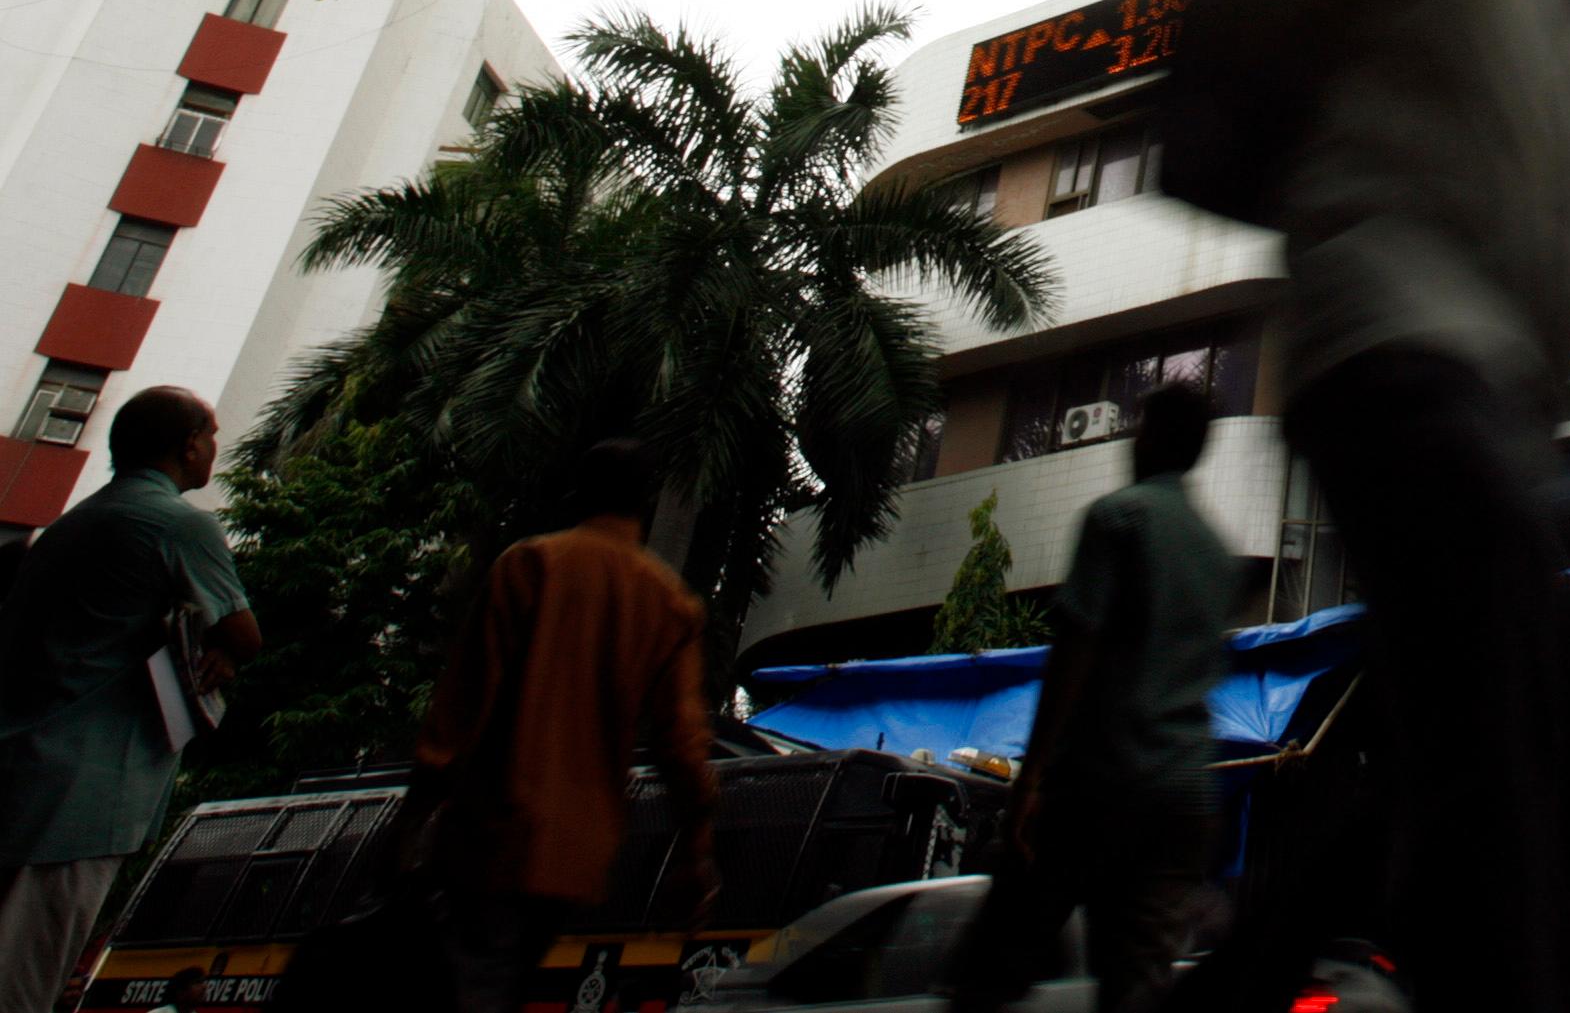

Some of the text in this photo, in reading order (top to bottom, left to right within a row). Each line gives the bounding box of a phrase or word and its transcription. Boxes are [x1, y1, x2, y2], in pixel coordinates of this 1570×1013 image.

[966, 10, 1086, 84] NTPC
[119, 980, 169, 1004] STATE
[232, 977, 281, 1003] POLIC
